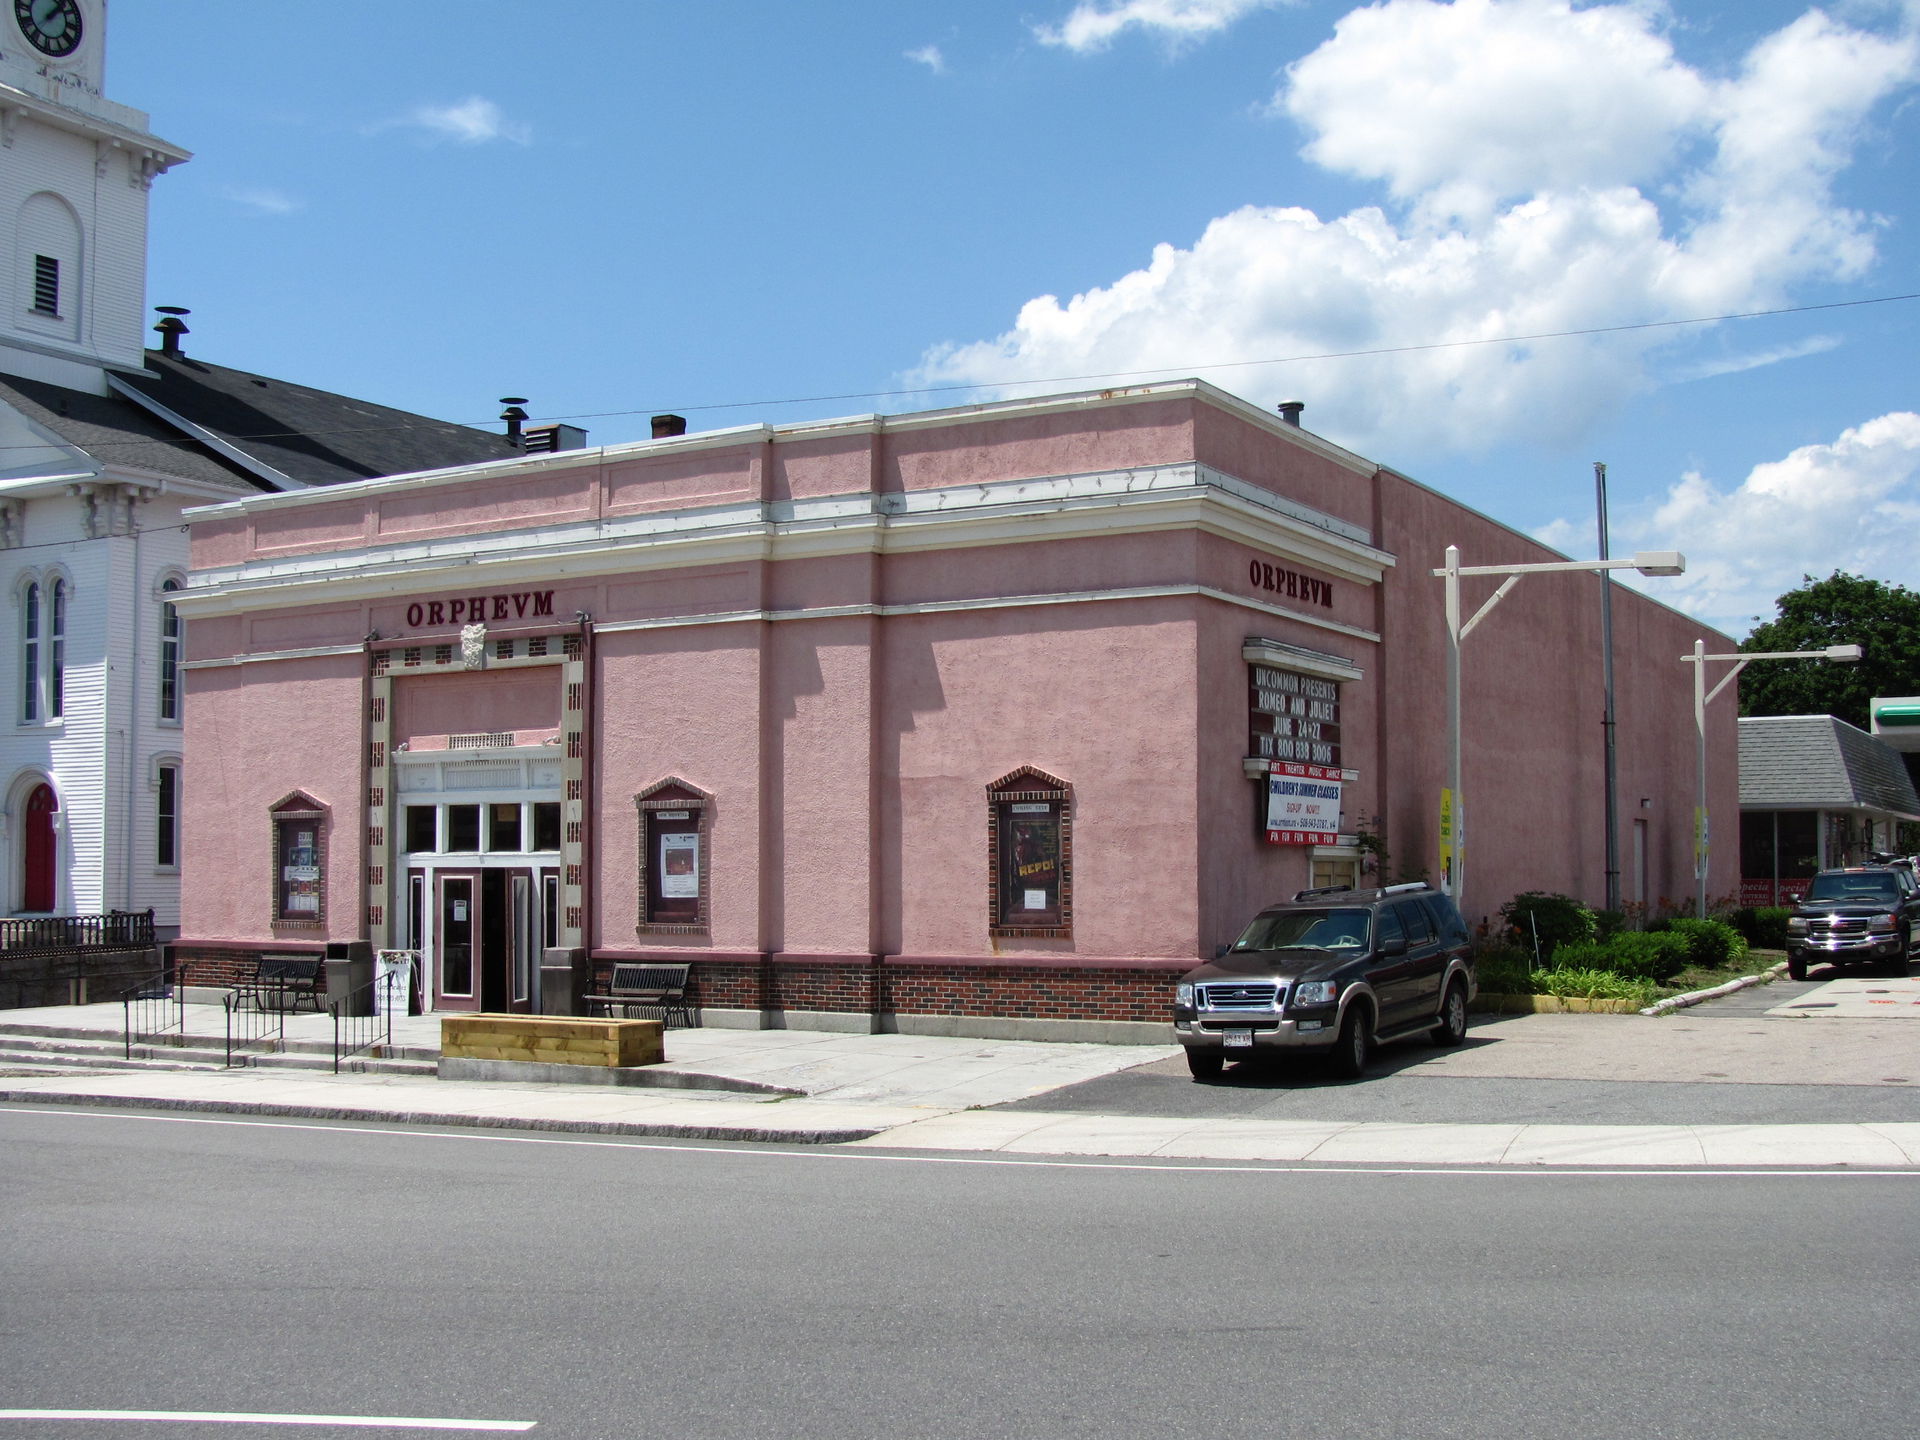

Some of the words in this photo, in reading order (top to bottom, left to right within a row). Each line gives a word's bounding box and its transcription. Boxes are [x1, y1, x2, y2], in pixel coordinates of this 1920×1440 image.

[1250, 559, 1333, 608] ORPHEVM
[406, 590, 555, 627] ORPHEVM
[1256, 667, 1299, 693] UNCOMMON
[1300, 677, 1336, 700] PRESENTS
[1259, 689, 1286, 712] ROMEO
[1290, 697, 1306, 716] AND
[1308, 701, 1334, 720] JULIET
[1273, 716, 1292, 736] JUNE
[1260, 736, 1274, 755] TIX
[1277, 739, 1294, 758] 800
[1312, 743, 1332, 763] 3006
[1270, 761, 1280, 772] ART
[1284, 764, 1305, 775] THEATER
[1308, 767, 1322, 777] MUSIC
[1326, 769, 1341, 779] DANCE
[1298, 782, 1318, 798] SUMMER
[1317, 785, 1339, 800] CLASSES
[1294, 832, 1304, 843] FUN
[1308, 833, 1319, 844] FUN
[1018, 859, 1055, 877] REPO!
